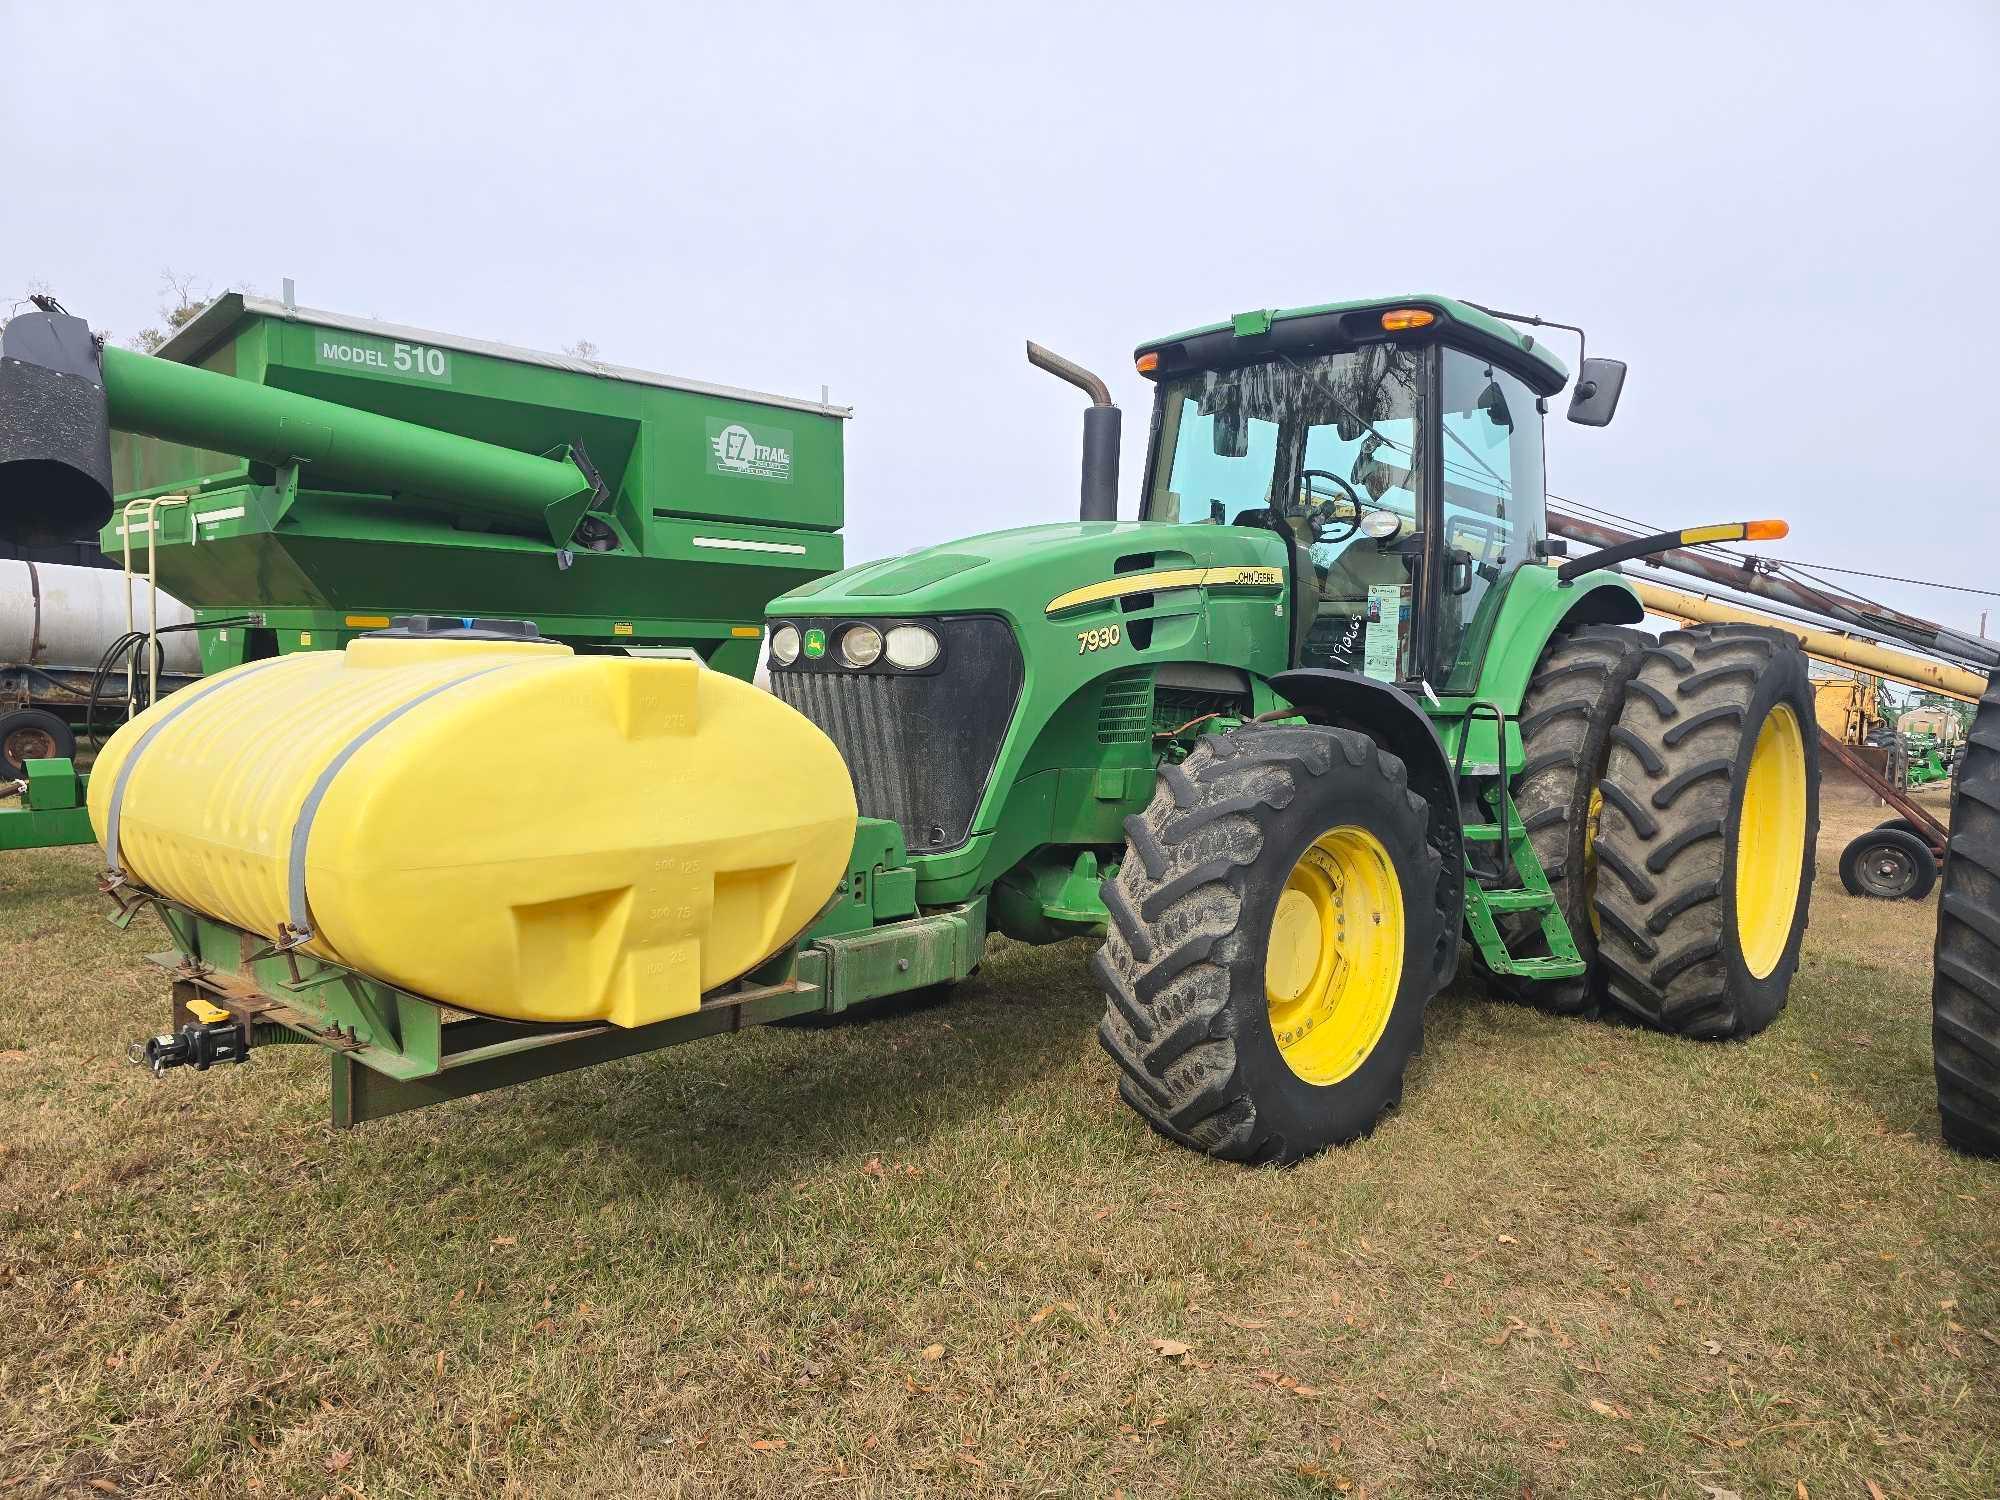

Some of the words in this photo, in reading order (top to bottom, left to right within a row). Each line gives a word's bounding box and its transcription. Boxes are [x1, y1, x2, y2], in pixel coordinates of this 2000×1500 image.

[323, 342, 388, 368] MODEL
[393, 342, 446, 376] 510
[1076, 623, 1121, 656] 7930
